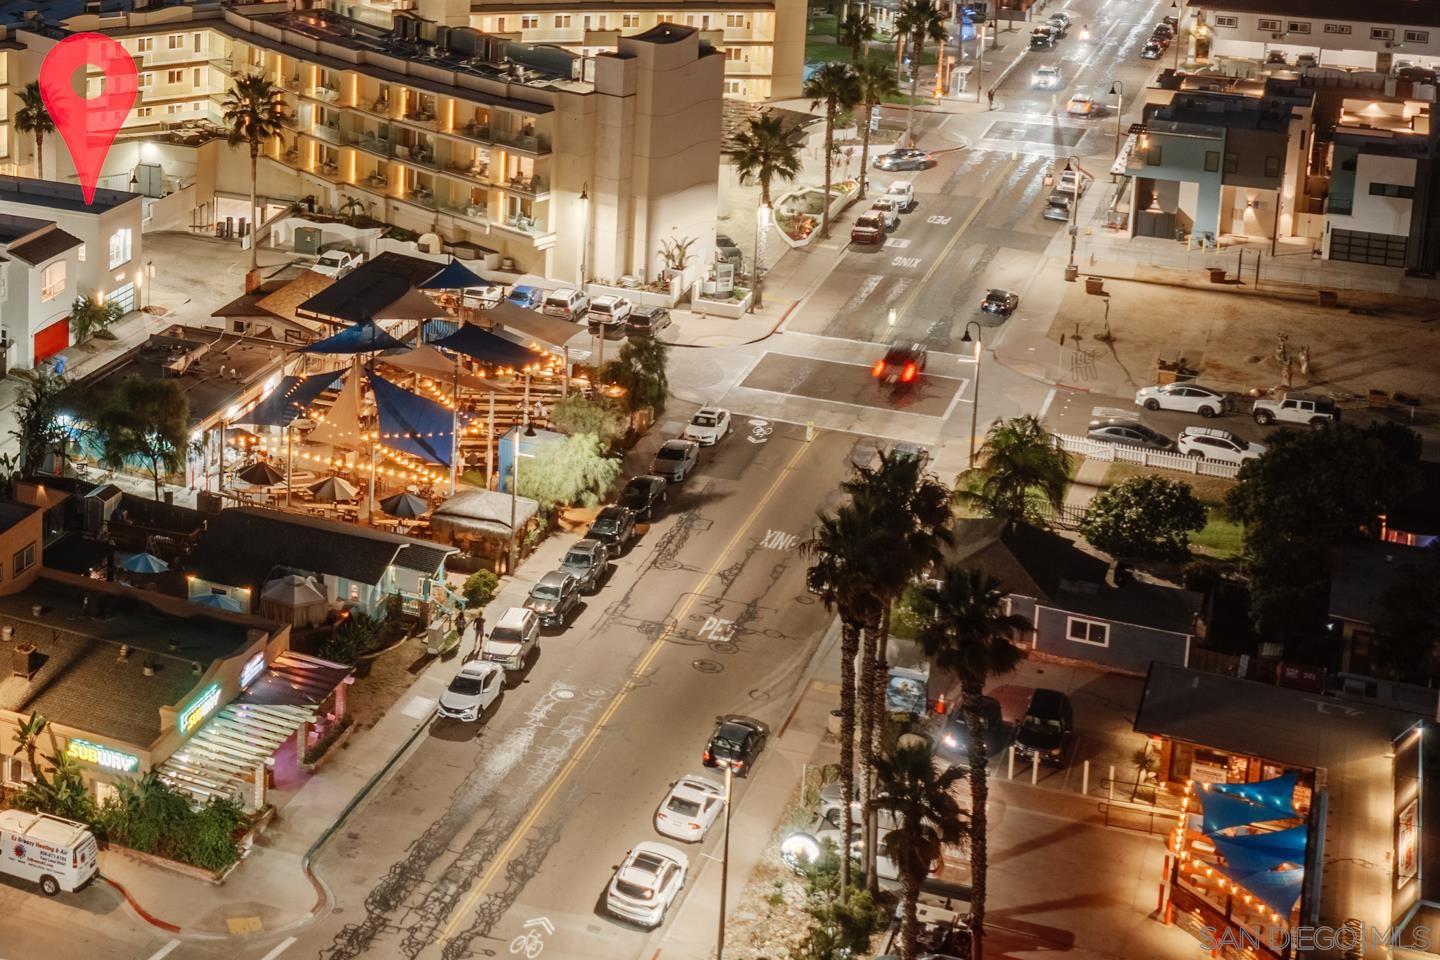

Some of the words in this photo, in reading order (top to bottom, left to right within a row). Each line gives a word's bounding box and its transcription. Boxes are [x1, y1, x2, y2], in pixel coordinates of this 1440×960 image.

[927, 215, 952, 225] PED
[891, 256, 922, 268] XING
[67, 742, 138, 772] SUBWAY
